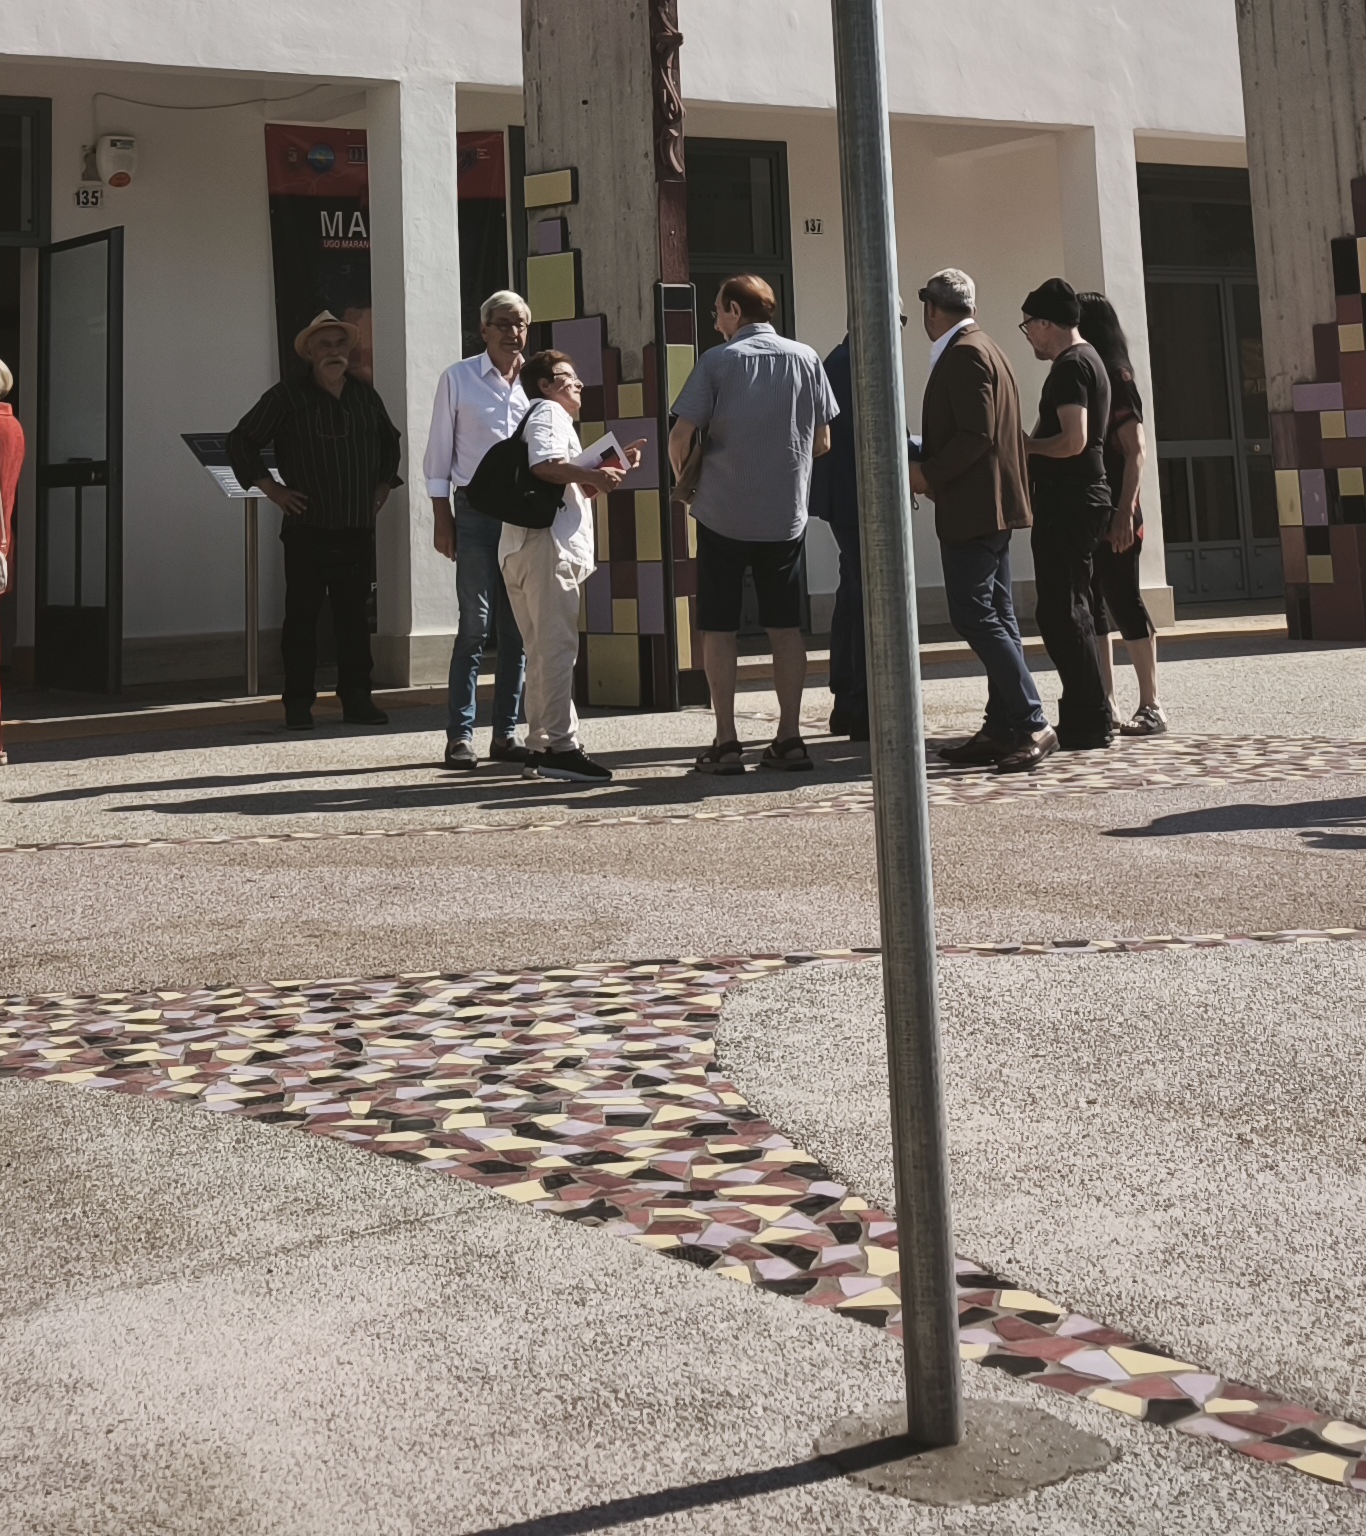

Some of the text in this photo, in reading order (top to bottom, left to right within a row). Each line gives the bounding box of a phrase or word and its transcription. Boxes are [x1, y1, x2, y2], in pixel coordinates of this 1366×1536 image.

[74, 189, 100, 206] 135
[320, 210, 368, 238] MA
[804, 218, 822, 233] 137
[323, 239, 370, 249] UGO MARAN
